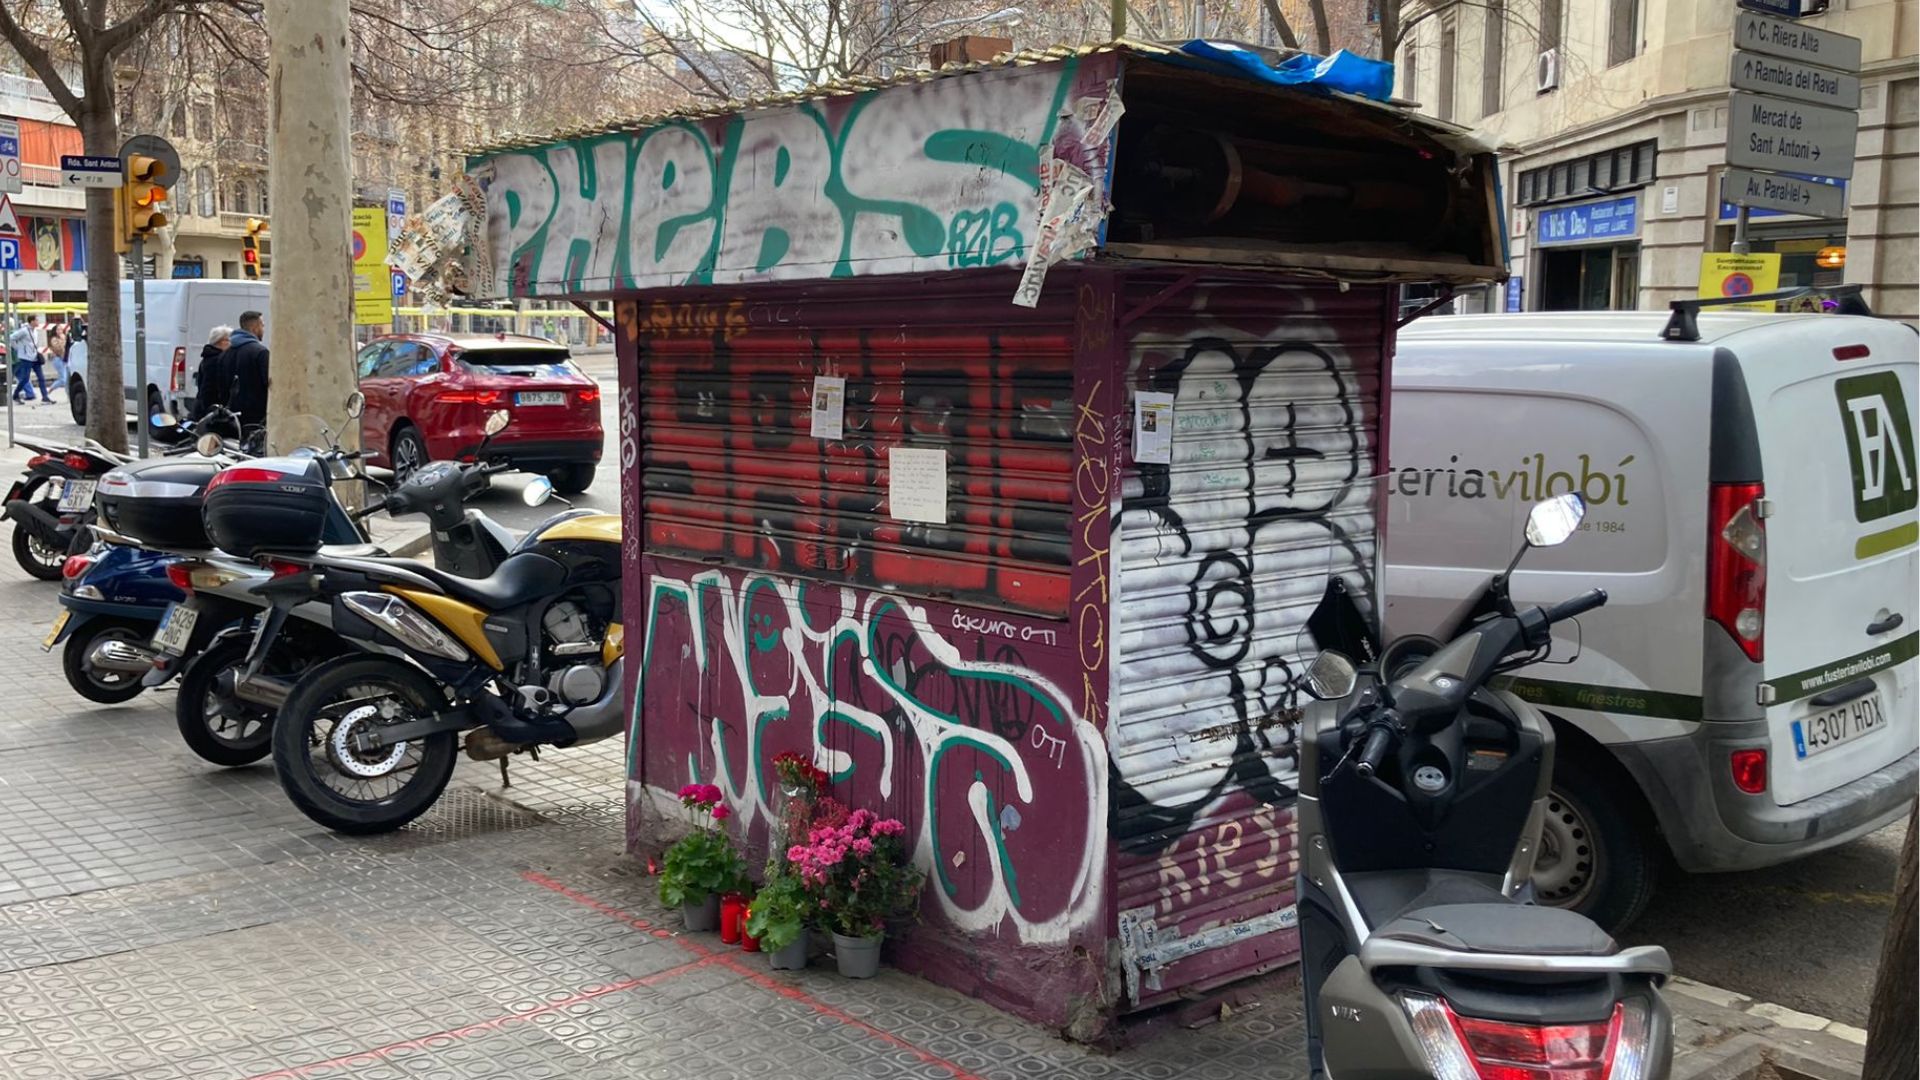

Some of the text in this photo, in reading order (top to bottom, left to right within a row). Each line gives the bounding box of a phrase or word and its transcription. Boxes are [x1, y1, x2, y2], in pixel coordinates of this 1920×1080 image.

[1759, 21, 1819, 53] C. Riera Alta
[1755, 61, 1838, 95] Rambla del Raval
[1752, 104, 1802, 130] Mercat de
[1749, 132, 1810, 159] Sant Antoni
[83, 159, 98, 167] Sant
[100, 160, 119, 168] Antoni
[1746, 177, 1761, 197] Av.
[1596, 521, 1625, 533] 1984
[171, 607, 195, 630] 5429
[1576, 689, 1647, 709] finestres
[1808, 695, 1884, 747] 4307 HDX
